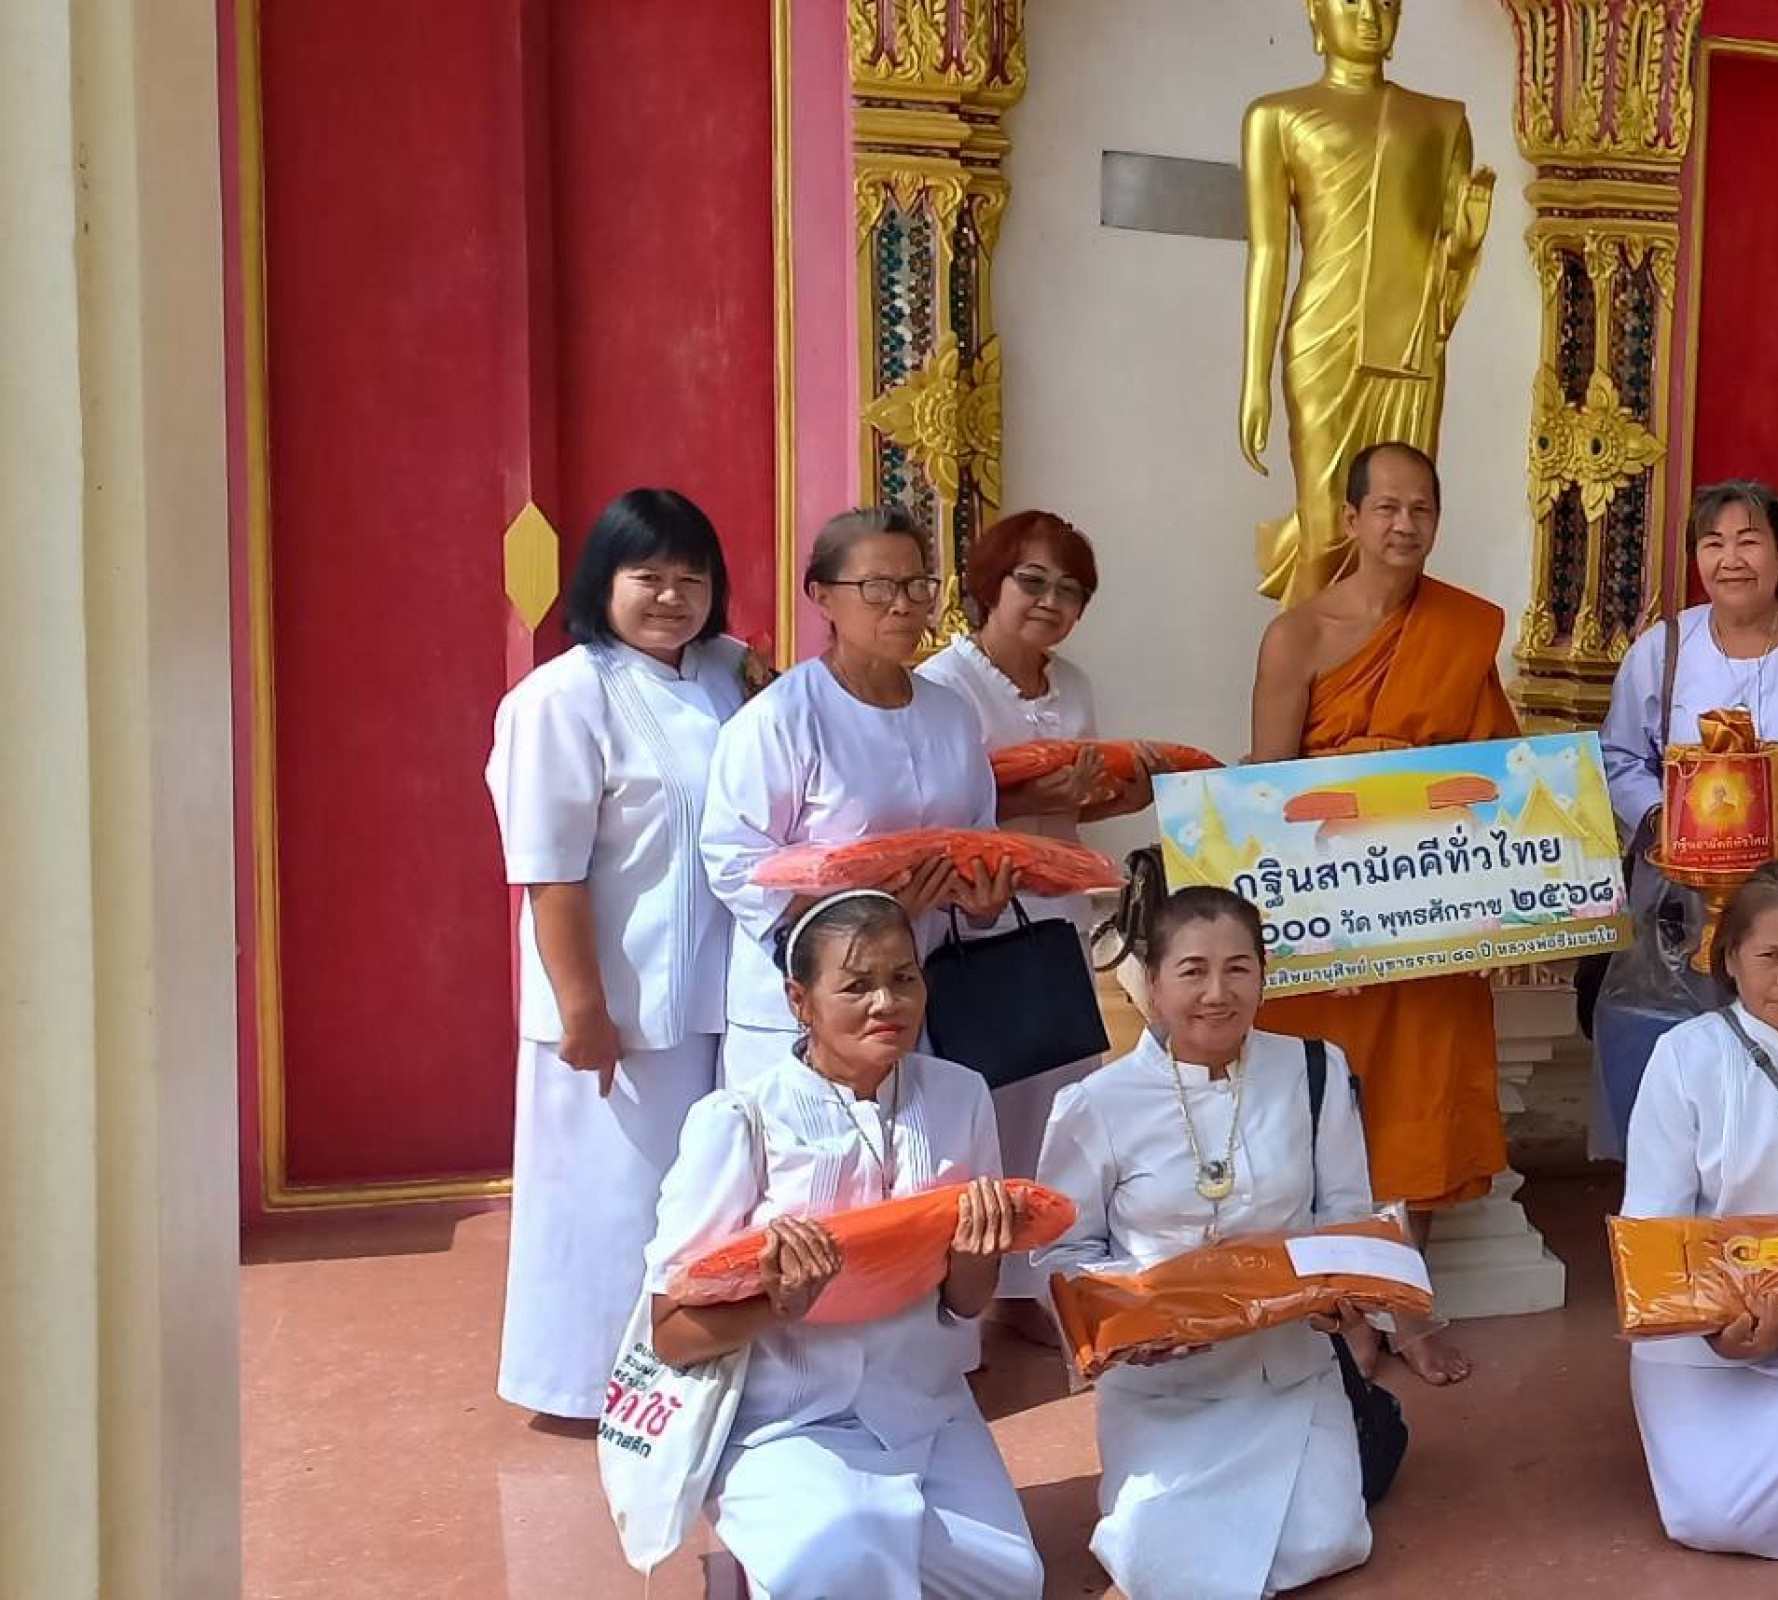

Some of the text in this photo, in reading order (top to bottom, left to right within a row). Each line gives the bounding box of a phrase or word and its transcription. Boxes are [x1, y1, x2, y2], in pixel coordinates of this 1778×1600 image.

[1234, 825, 1562, 909] กฐินสามัคคีทั่วไทย
[1341, 909, 1371, 934] วัด
[1377, 898, 1502, 937] พุทธศักราช
[1510, 876, 1614, 911] ๒๕๖๘
